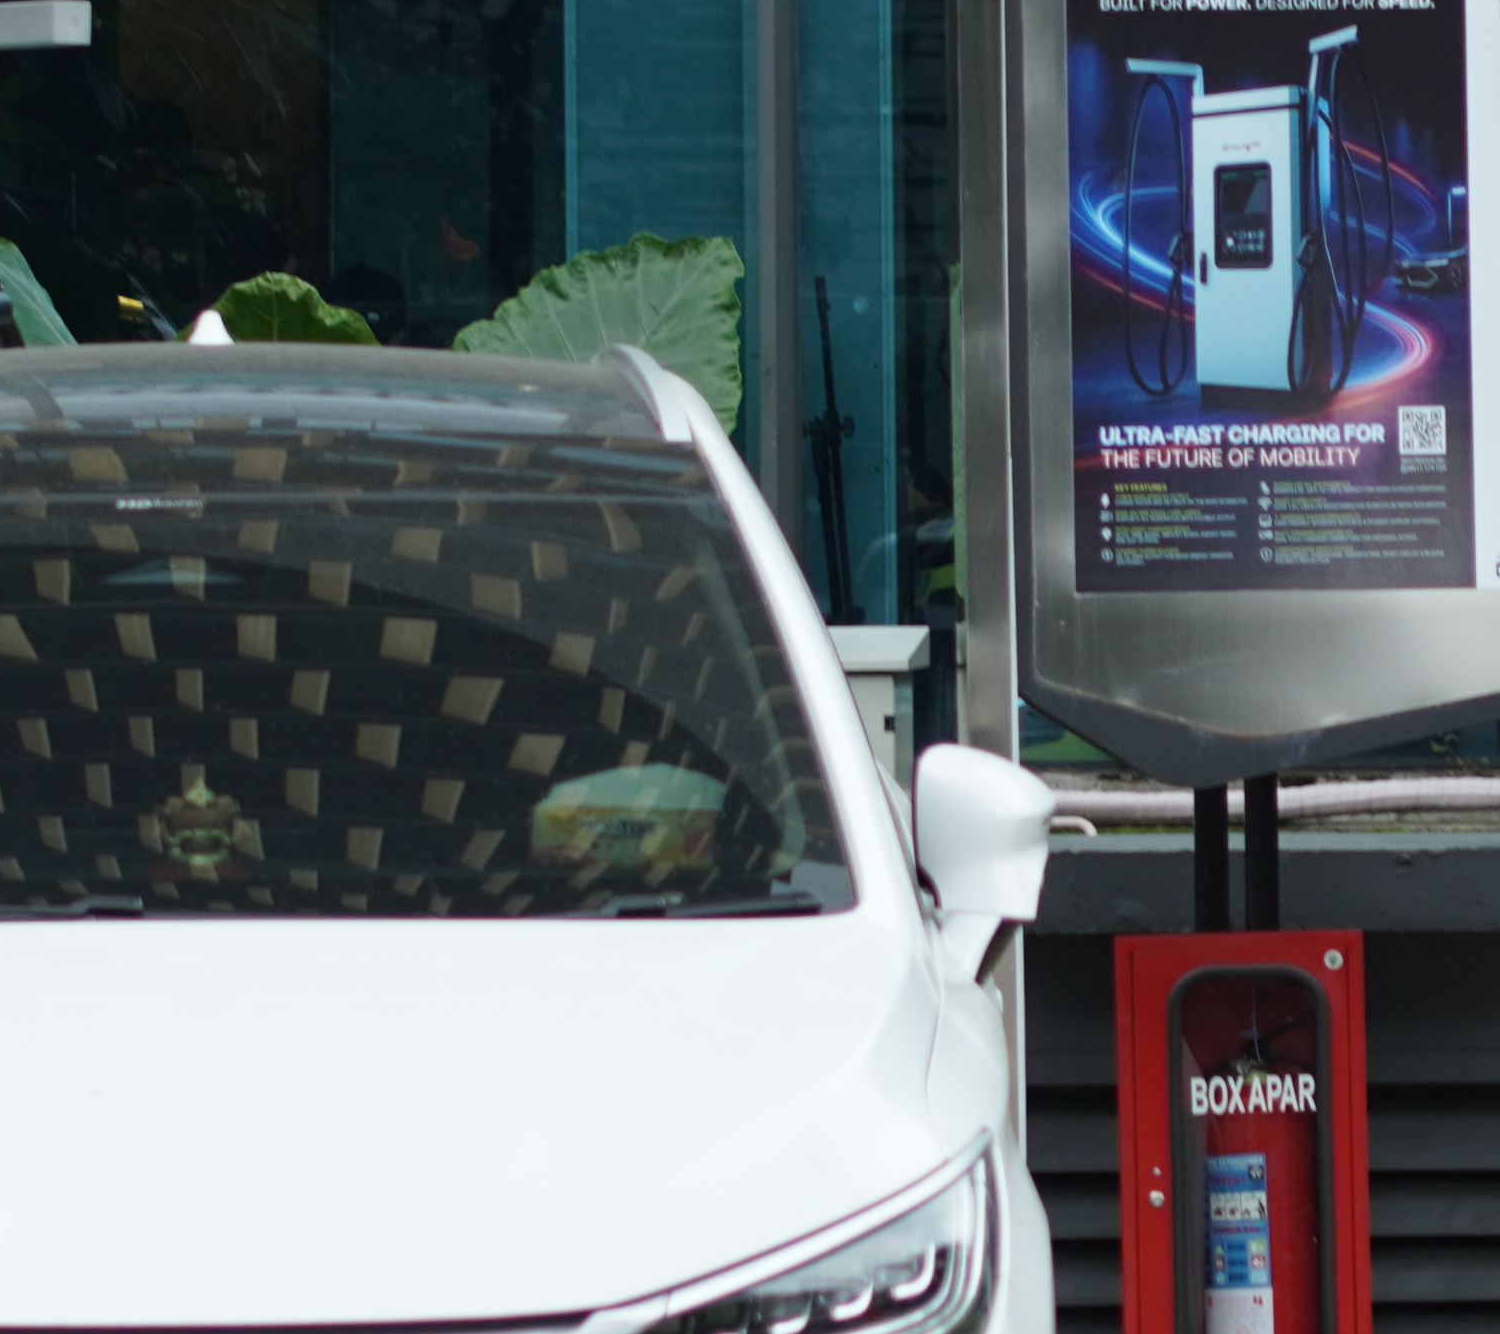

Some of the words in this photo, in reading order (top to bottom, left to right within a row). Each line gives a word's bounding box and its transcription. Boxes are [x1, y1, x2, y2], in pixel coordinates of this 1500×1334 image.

[1100, 425, 1225, 447] ULTRA-FAST
[1228, 423, 1340, 445] CHARGING
[1344, 423, 1386, 444] FOR
[1101, 448, 1141, 469] THE
[1145, 447, 1223, 469] FUTURE
[1227, 446, 1255, 468] OF
[1259, 446, 1361, 467] MOBILITY
[1191, 1076, 1245, 1116] BOX
[1247, 1073, 1318, 1114] APAR
